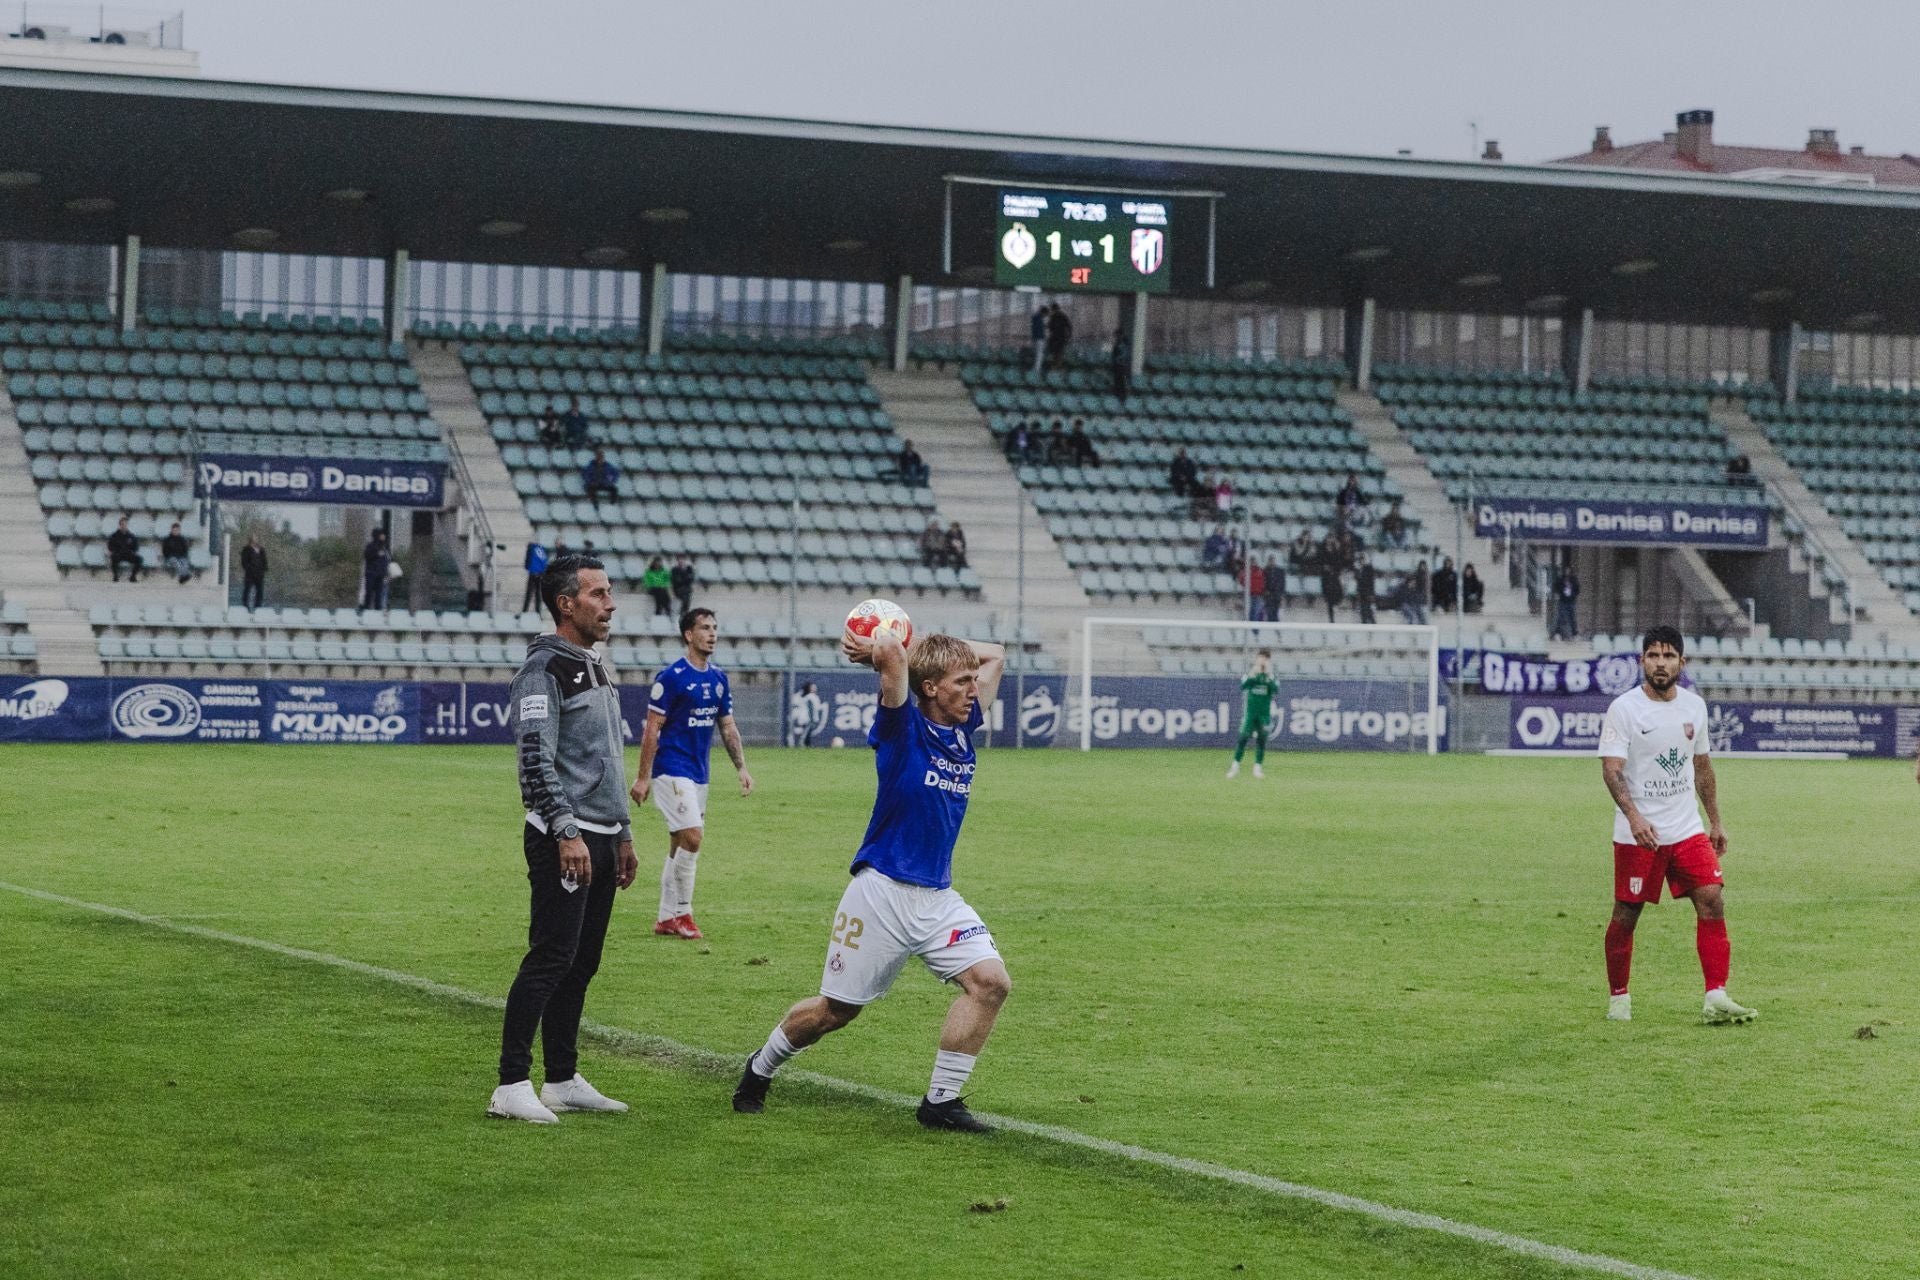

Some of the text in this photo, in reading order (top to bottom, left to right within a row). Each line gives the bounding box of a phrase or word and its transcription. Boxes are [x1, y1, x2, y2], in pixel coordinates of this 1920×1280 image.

[1046, 231, 1061, 260] 1
[1098, 234, 1114, 263] 1
[200, 463, 429, 493] Danisa Danisa
[1576, 507, 1663, 531] Danisa
[1672, 510, 1757, 534] Danisa
[1484, 653, 1560, 692] GATE
[271, 713, 407, 735] MUNDO
[1066, 701, 1229, 740] agropal
[1289, 705, 1446, 742] agropal
[831, 912, 864, 950] 22
